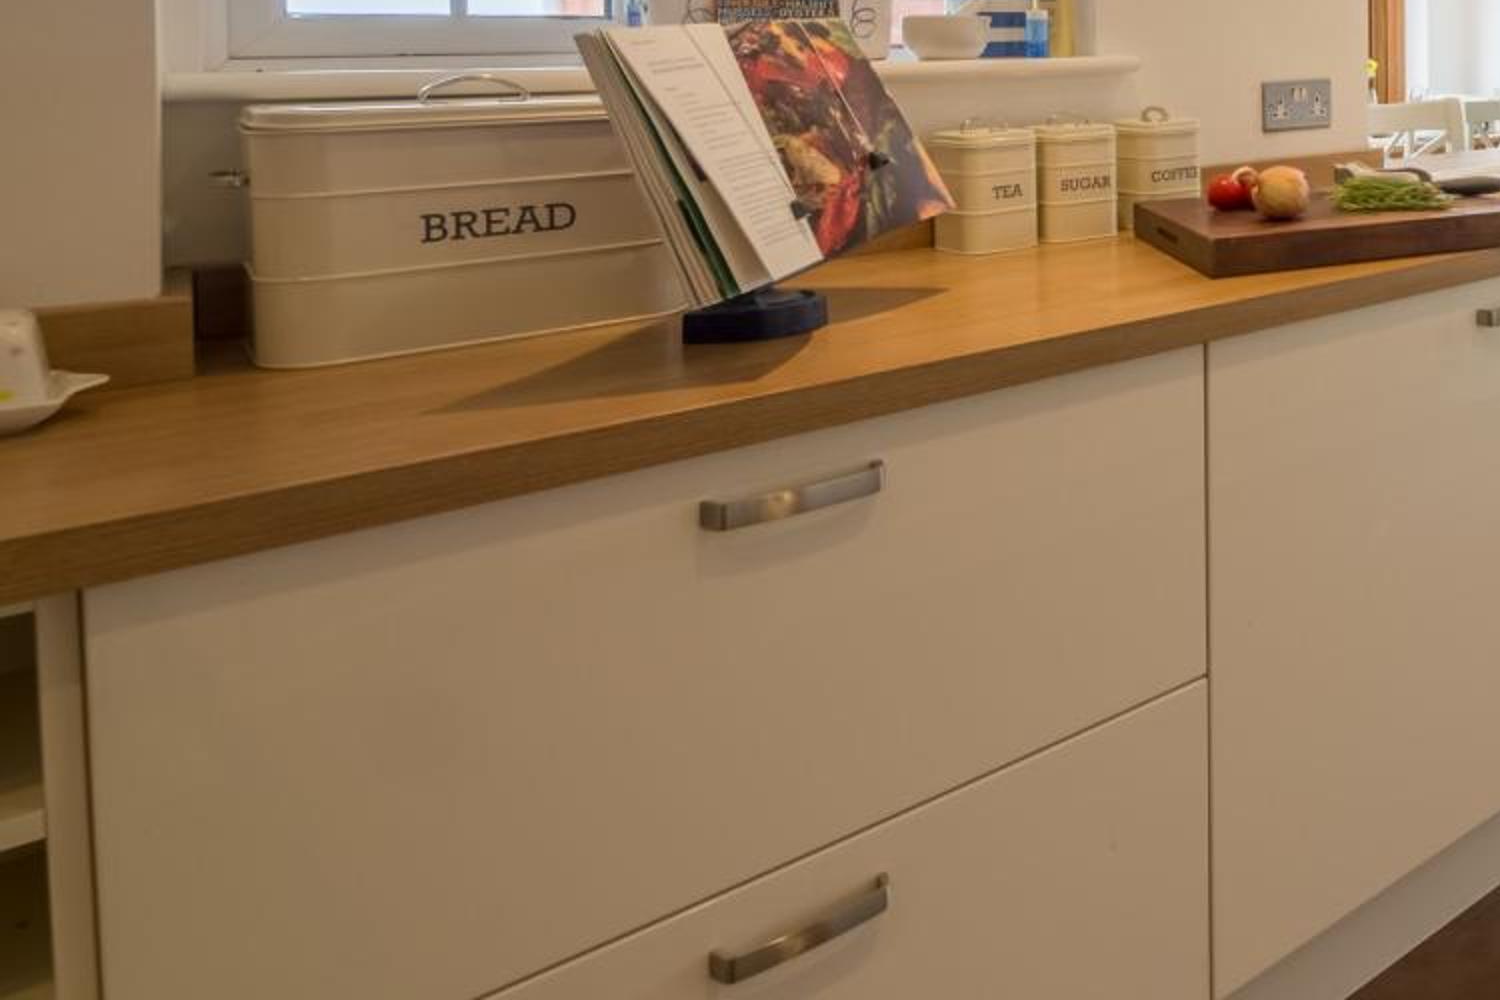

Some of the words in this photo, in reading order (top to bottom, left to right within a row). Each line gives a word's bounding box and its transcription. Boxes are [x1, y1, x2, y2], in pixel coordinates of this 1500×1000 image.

[992, 183, 1024, 200] TEA
[1059, 175, 1111, 192] SUGAR
[420, 202, 576, 244] BREAD
